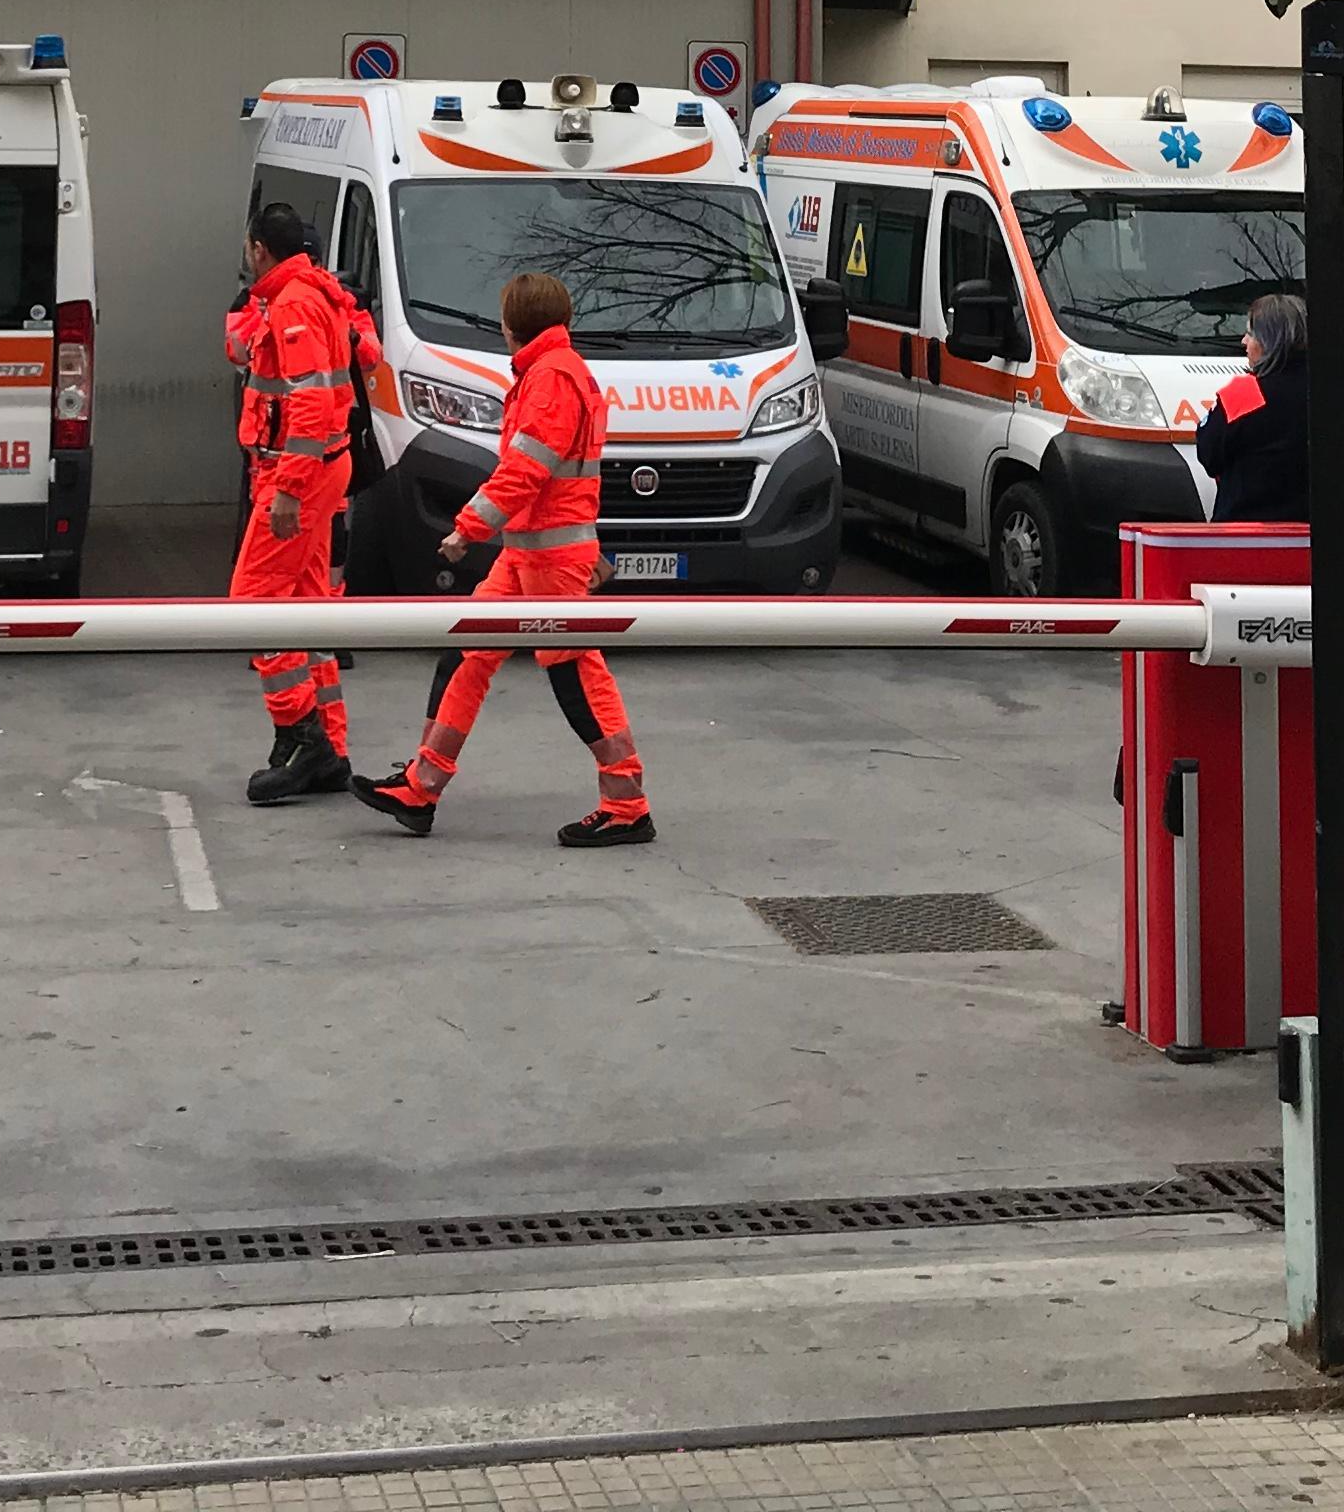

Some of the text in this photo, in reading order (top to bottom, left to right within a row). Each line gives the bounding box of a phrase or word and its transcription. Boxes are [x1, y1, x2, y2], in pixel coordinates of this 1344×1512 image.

[799, 195, 821, 232] 118
[518, 619, 567, 633] FAAC
[1009, 620, 1056, 633] FAAC
[1238, 617, 1313, 642] FAAC
